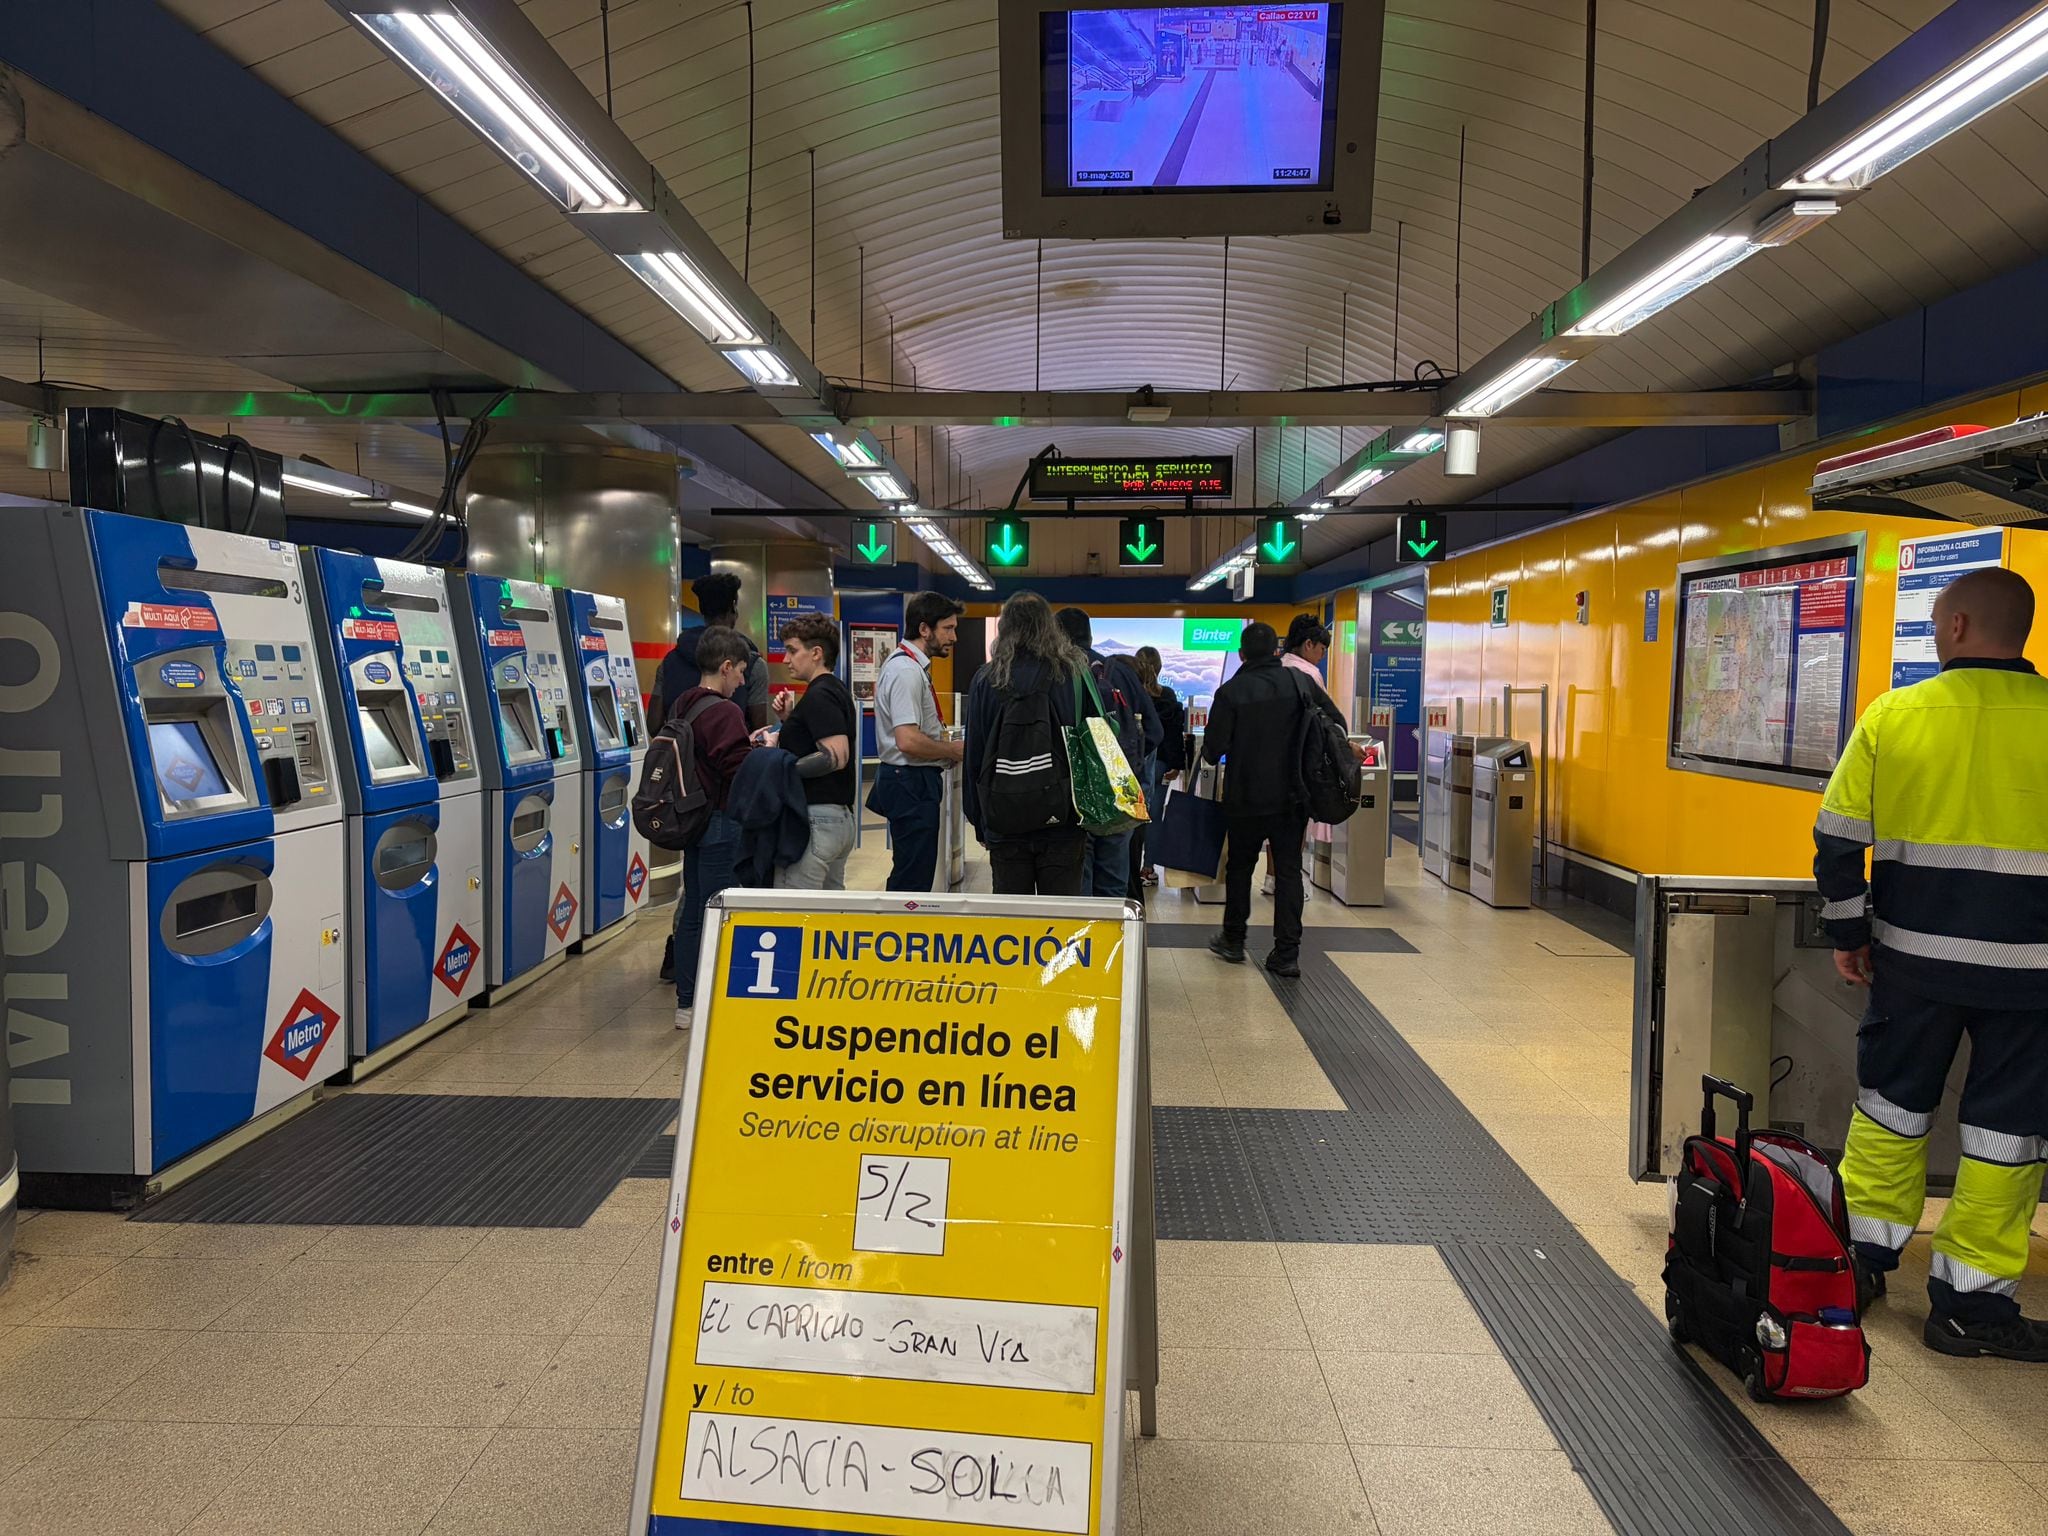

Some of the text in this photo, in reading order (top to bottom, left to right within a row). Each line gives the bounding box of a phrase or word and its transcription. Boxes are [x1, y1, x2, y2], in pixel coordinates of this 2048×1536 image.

[1259, 11, 1316, 21] Callao C22 V1
[1077, 172, 1131, 181] 19-may-2026
[1274, 169, 1310, 178] 11:24:47
[1155, 463, 1212, 474] SERVICIO
[1917, 543, 1950, 555] INFORMACIÓN
[1955, 539, 1980, 550] CLIENTES
[1916, 555, 1940, 564] Information
[1946, 553, 1959, 561] users
[291, 581, 302, 605] 3
[1703, 578, 1737, 591] EMERGENCIA
[441, 593, 448, 612] 4
[788, 598, 796, 607] 3
[143, 611, 163, 622] MULTI
[1192, 628, 1234, 641] Binter
[629, 869, 642, 887] Metro
[554, 902, 571, 922] Metro
[812, 926, 1092, 968] INFORMACIÓN
[446, 951, 469, 973] Metro
[806, 969, 999, 1005] Information
[287, 1020, 322, 1051] Metro
[773, 1015, 1060, 1060] Suspendido el
[748, 1068, 1077, 1113] servicio en línea
[739, 1111, 1079, 1153] Service disruption at line
[859, 1160, 937, 1229] 5/2
[707, 1253, 854, 1281] entre / from
[701, 1297, 731, 1335] EL
[887, 1319, 958, 1357] GRAN
[691, 1380, 755, 1409] y / to
[696, 1418, 869, 1496] ALSACIA
